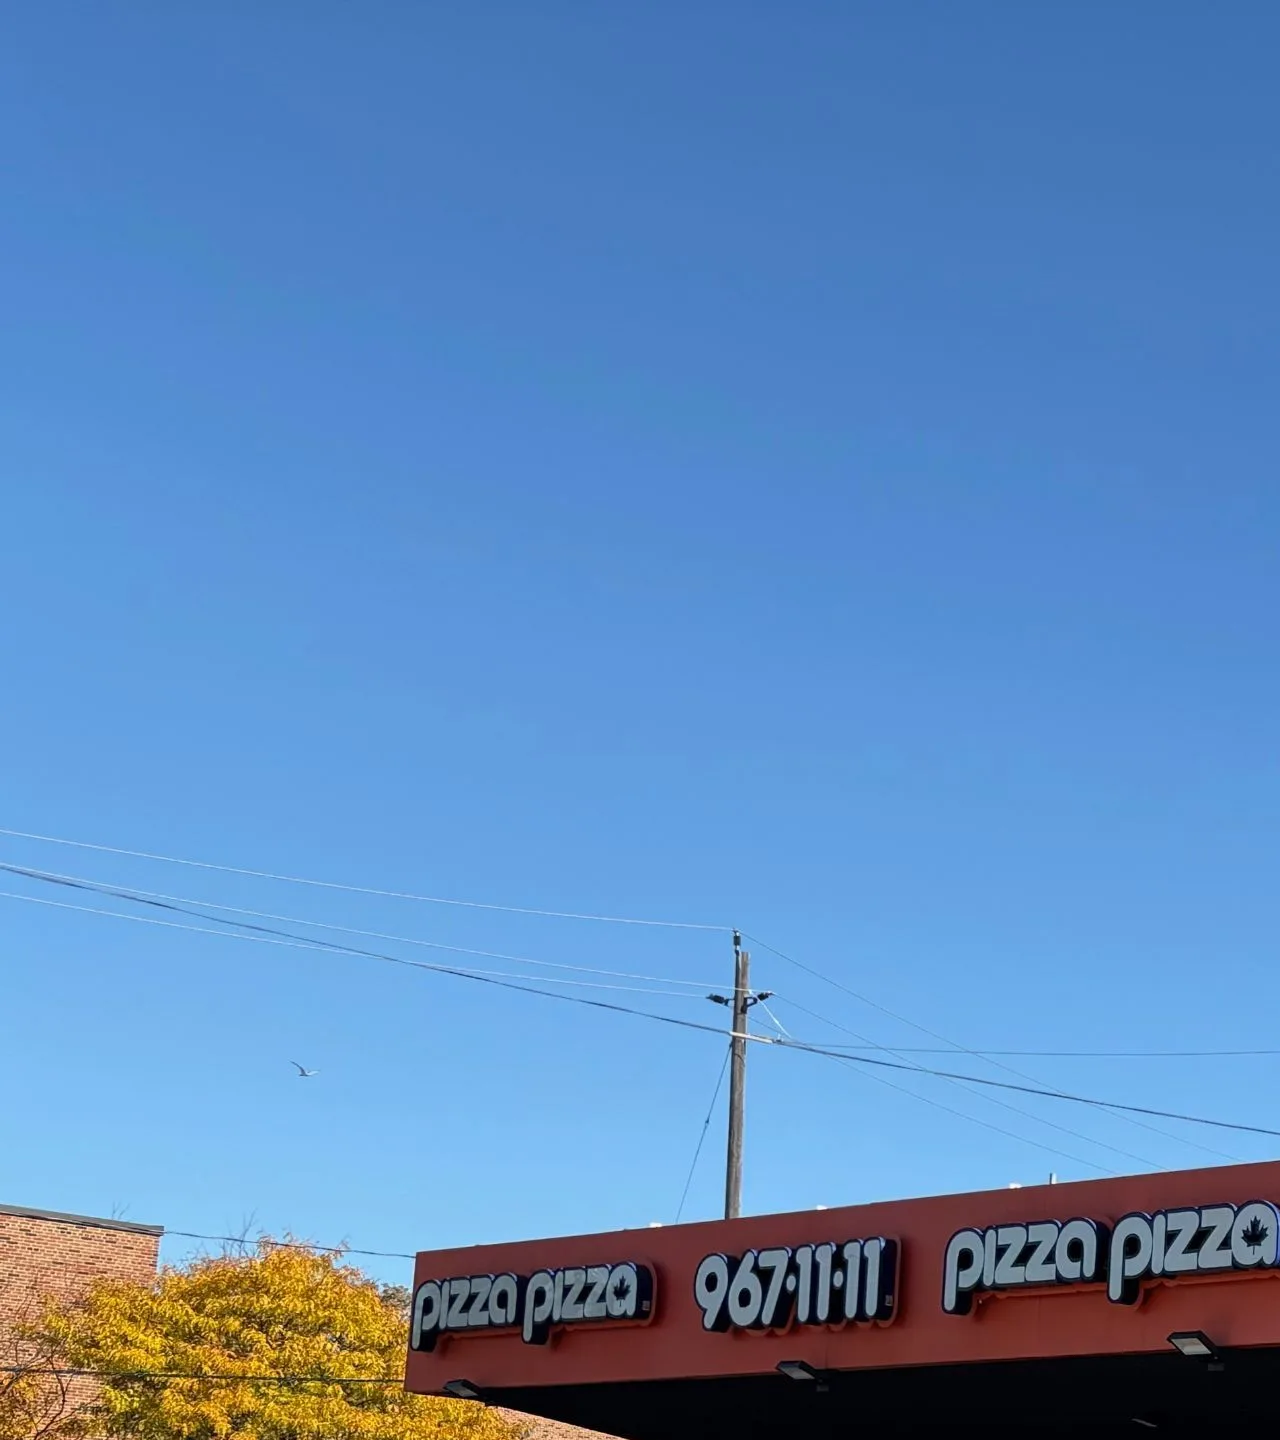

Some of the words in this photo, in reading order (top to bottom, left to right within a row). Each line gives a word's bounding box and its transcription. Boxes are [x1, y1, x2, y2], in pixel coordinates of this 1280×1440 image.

[943, 1217, 1099, 1312] pizza
[1109, 1199, 1280, 1302] pizza
[411, 1274, 518, 1351] pizza
[522, 1262, 638, 1343] pizza
